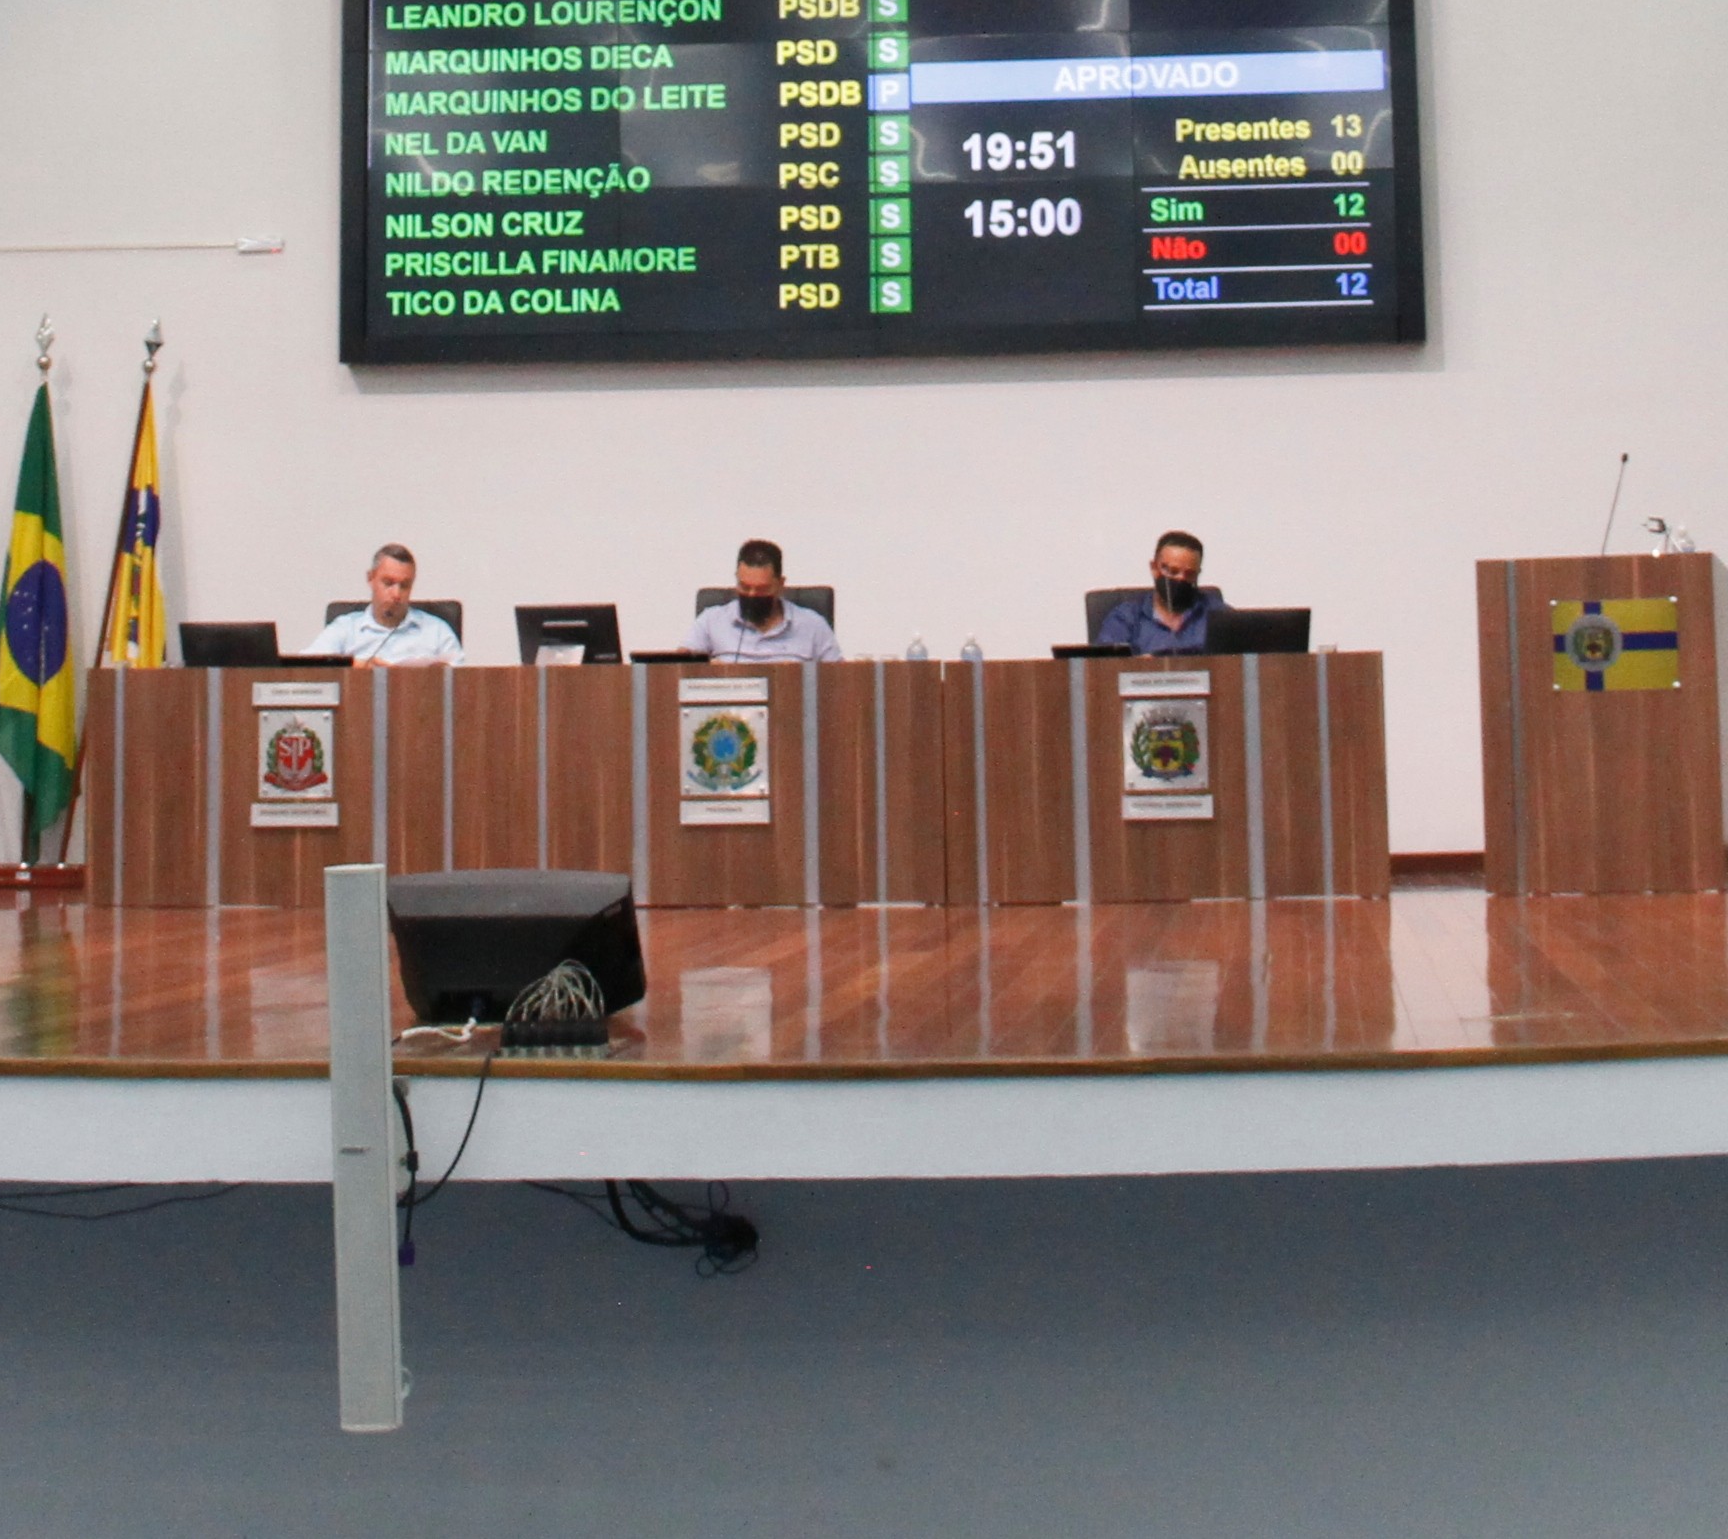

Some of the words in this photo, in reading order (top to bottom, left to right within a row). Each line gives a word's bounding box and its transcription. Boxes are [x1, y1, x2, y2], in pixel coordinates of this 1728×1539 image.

[386, 2, 525, 29] LEANDRO
[386, 46, 581, 74] MARQUINHOS
[591, 45, 673, 70] DECA
[777, 41, 837, 64] PSD
[878, 39, 898, 61] S
[1054, 61, 1238, 93] APROVADO
[386, 89, 582, 116] MARQUINHOS
[591, 86, 635, 111] DO
[644, 85, 725, 109] LEITE
[780, 82, 861, 106] PSDB
[881, 81, 898, 102] P
[385, 134, 438, 155] NEL
[447, 133, 485, 154] DA
[492, 131, 547, 152] VAN
[780, 123, 840, 147] PSD
[879, 122, 899, 144] S
[1176, 117, 1310, 142] Presentes
[1330, 115, 1362, 137] 13
[963, 131, 1076, 170] 19:51
[1180, 154, 1305, 179] Ausentes
[1332, 151, 1362, 176] 00
[386, 172, 473, 196] NILDO
[483, 165, 650, 197] REDENÇÃO
[780, 164, 839, 187] PSC
[880, 163, 899, 184] S
[386, 214, 493, 238] NILSON
[502, 211, 583, 235] CRUZ
[780, 206, 840, 230] PSD
[880, 205, 900, 227] S
[964, 199, 1082, 238] 15:00
[1151, 198, 1203, 222] Sim
[1333, 193, 1365, 217] 12
[386, 253, 534, 277] PRISCILLA
[543, 248, 696, 273] FINAMORE
[780, 246, 840, 269] PTB
[881, 244, 900, 266] S
[1151, 236, 1206, 260] Não
[1335, 232, 1367, 255] 00
[388, 292, 455, 316] TICO
[464, 290, 503, 314] DA
[510, 289, 620, 313] COLINA
[780, 285, 840, 308] PSD
[881, 284, 900, 305] S
[1153, 277, 1218, 300] Total
[1335, 273, 1367, 296] 12
